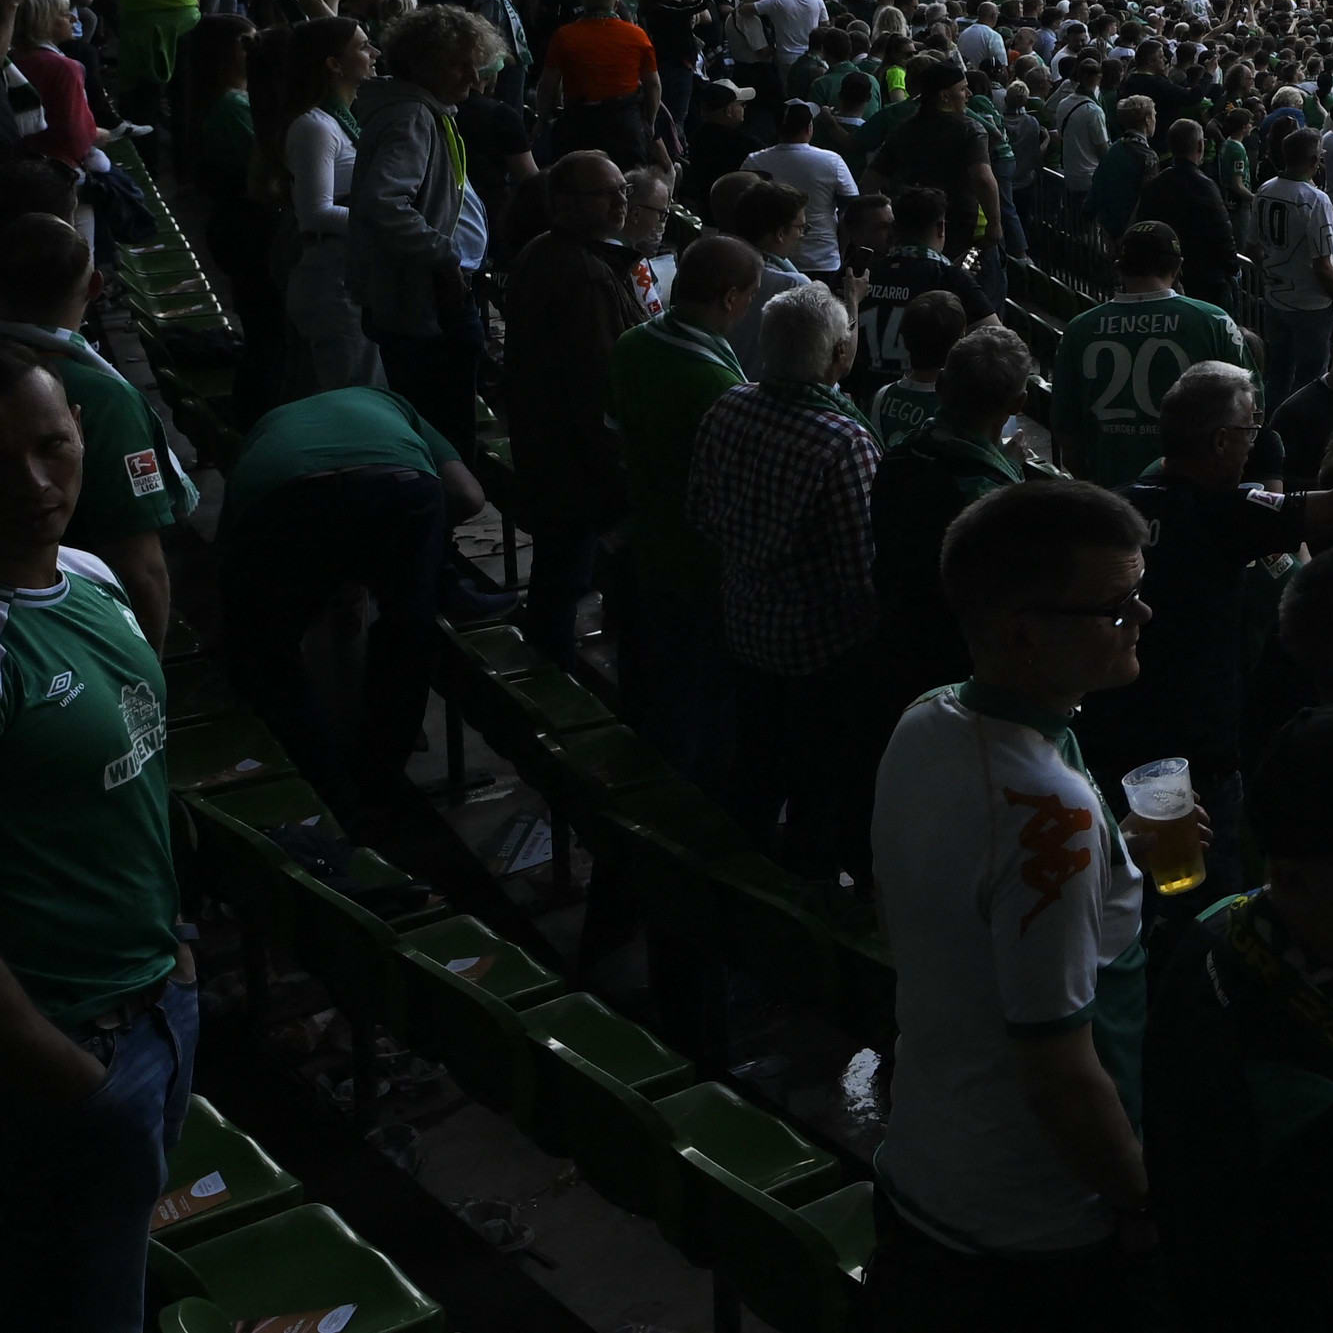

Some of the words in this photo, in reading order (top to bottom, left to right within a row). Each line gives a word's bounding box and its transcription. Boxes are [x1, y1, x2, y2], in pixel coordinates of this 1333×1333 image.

[867, 284, 910, 301] PIZARRO
[1092, 314, 1180, 335] JENSEN
[1082, 337, 1190, 421] 20
[881, 396, 925, 426] IEGO
[59, 682, 85, 709] umbro
